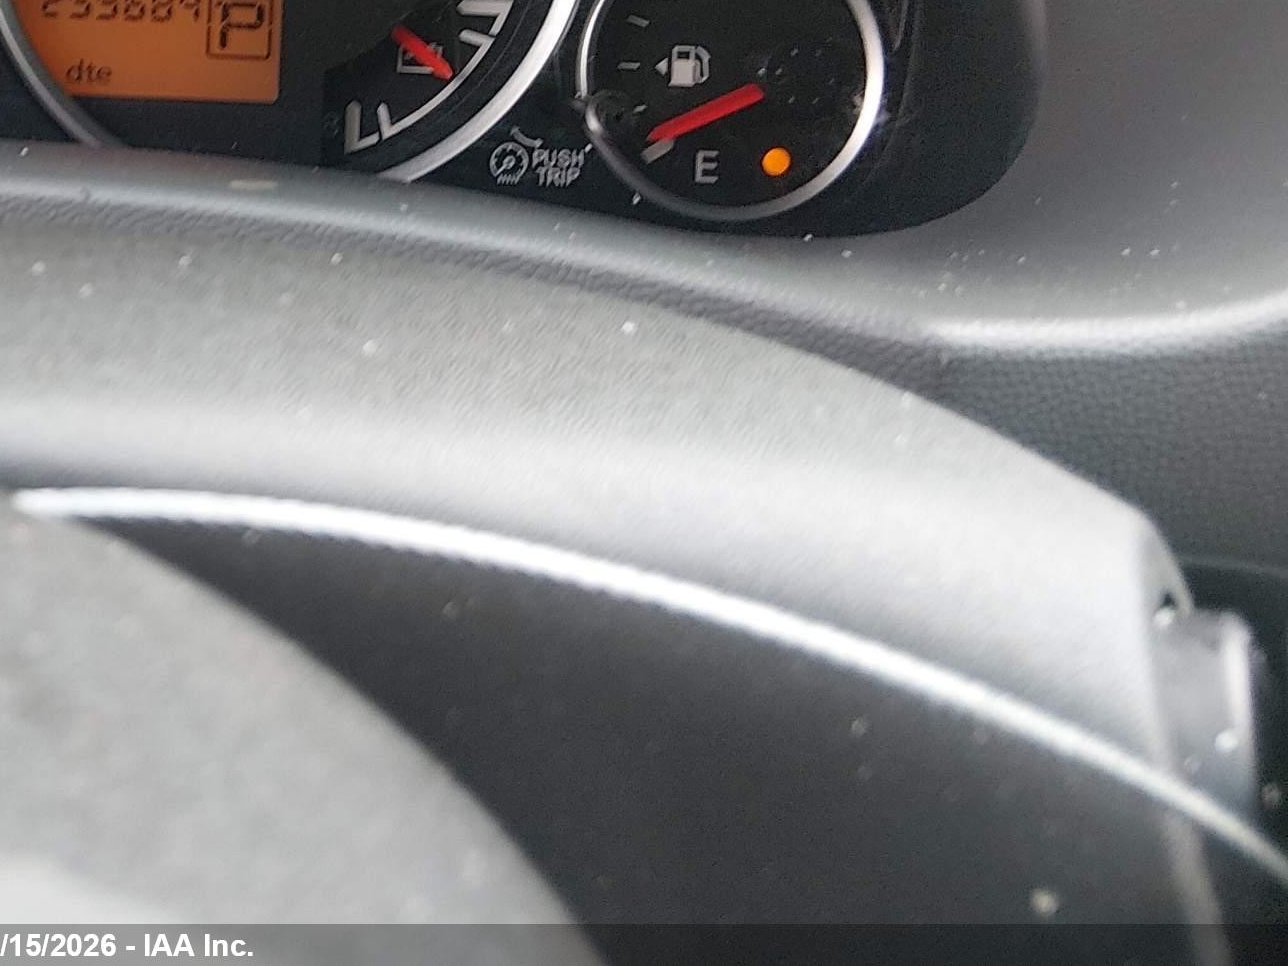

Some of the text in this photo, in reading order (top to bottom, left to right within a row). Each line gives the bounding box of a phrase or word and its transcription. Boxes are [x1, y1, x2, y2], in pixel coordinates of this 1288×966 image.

[215, 0, 266, 50] P
[65, 57, 113, 85] dte
[531, 148, 585, 167] PUSH
[694, 149, 719, 185] E
[536, 166, 581, 187] TRIP
